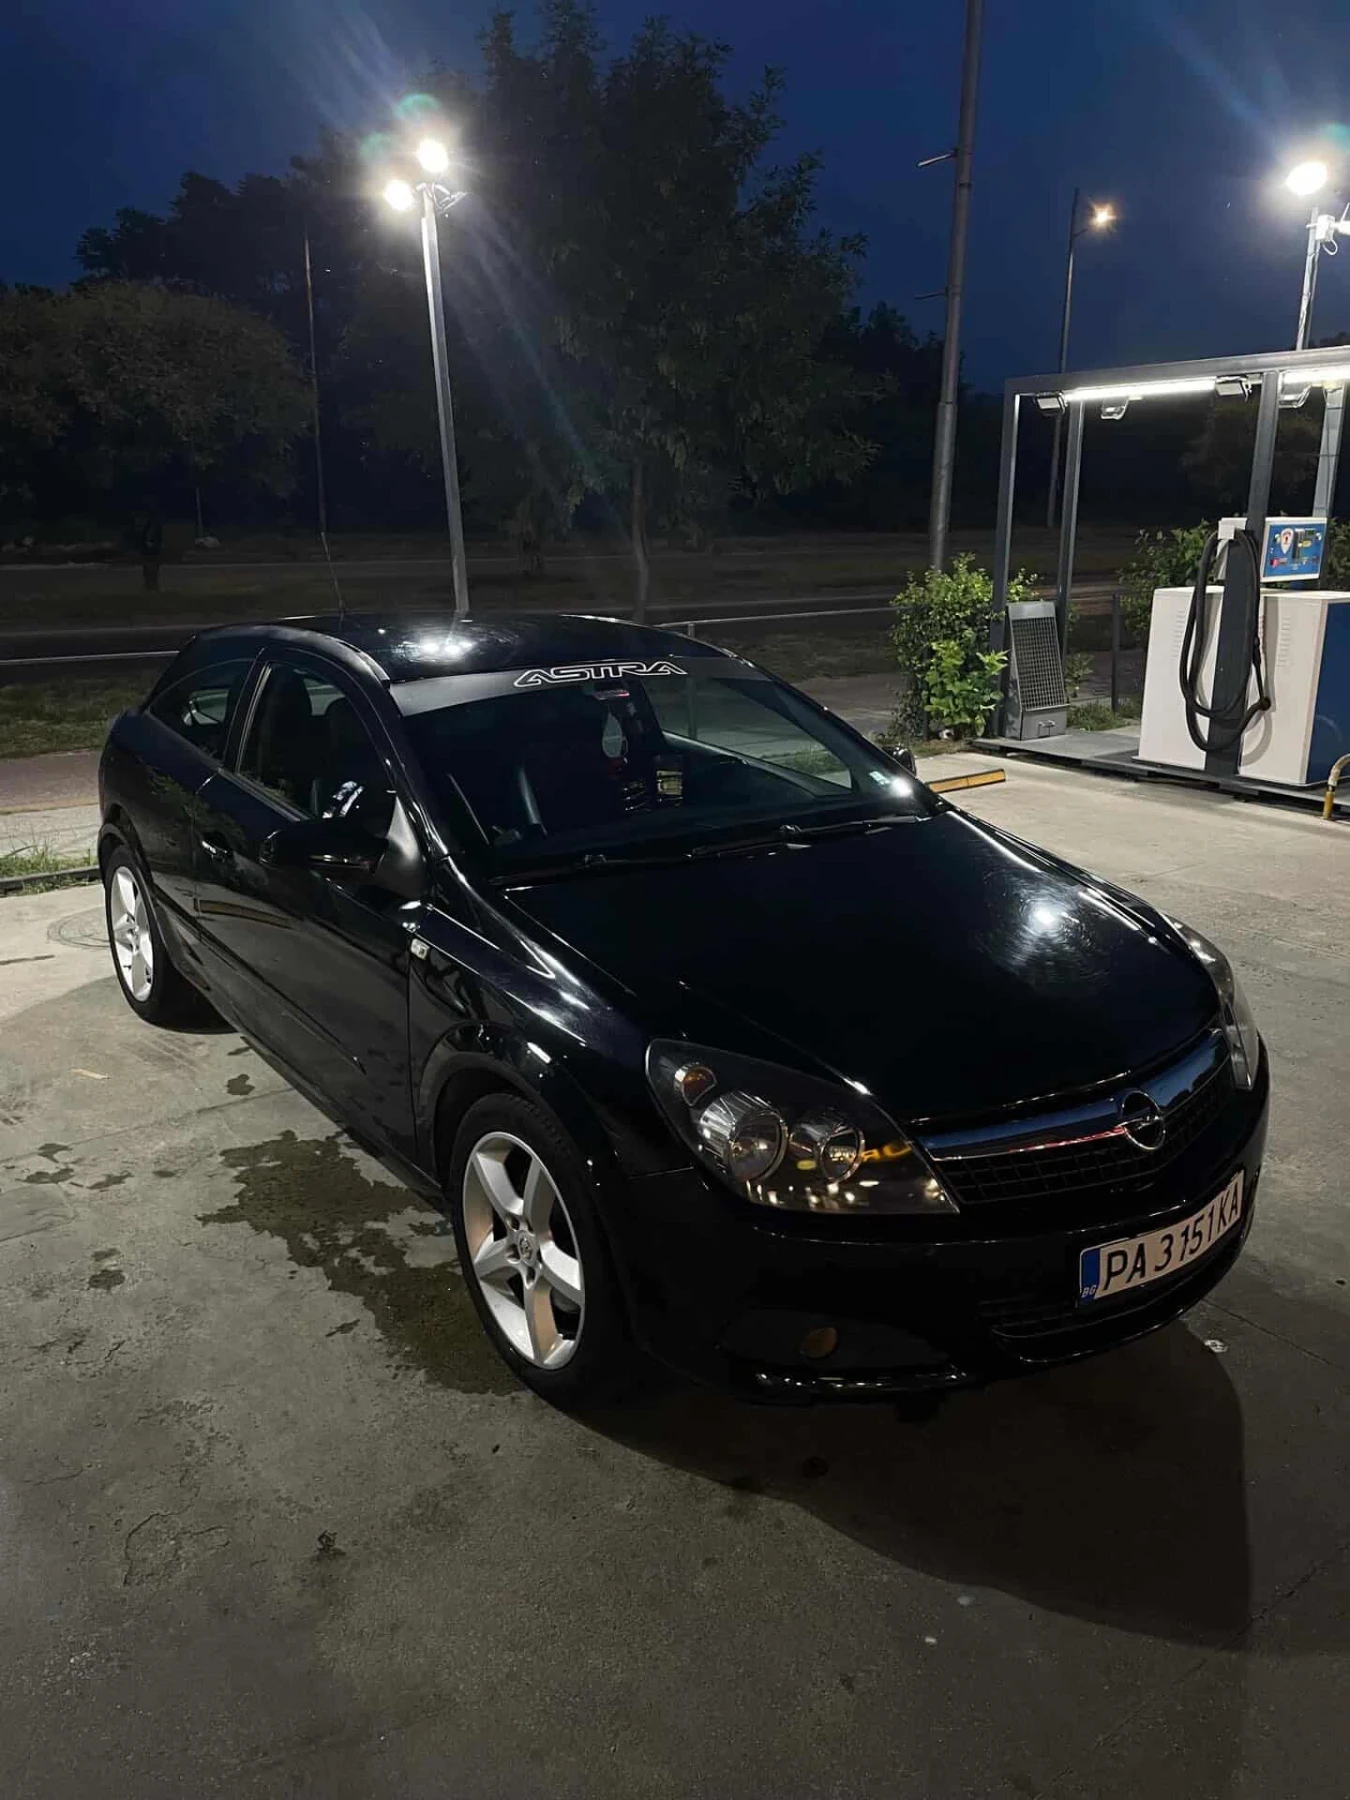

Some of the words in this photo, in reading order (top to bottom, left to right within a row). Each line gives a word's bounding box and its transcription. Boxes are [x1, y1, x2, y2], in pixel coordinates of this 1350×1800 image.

[513, 661, 688, 687] ASTRA
[1103, 1243, 1146, 1291] PA
[1154, 1205, 1215, 1272] 3151
[1217, 1182, 1238, 1234] KA
[1081, 1285, 1096, 1298] BG
